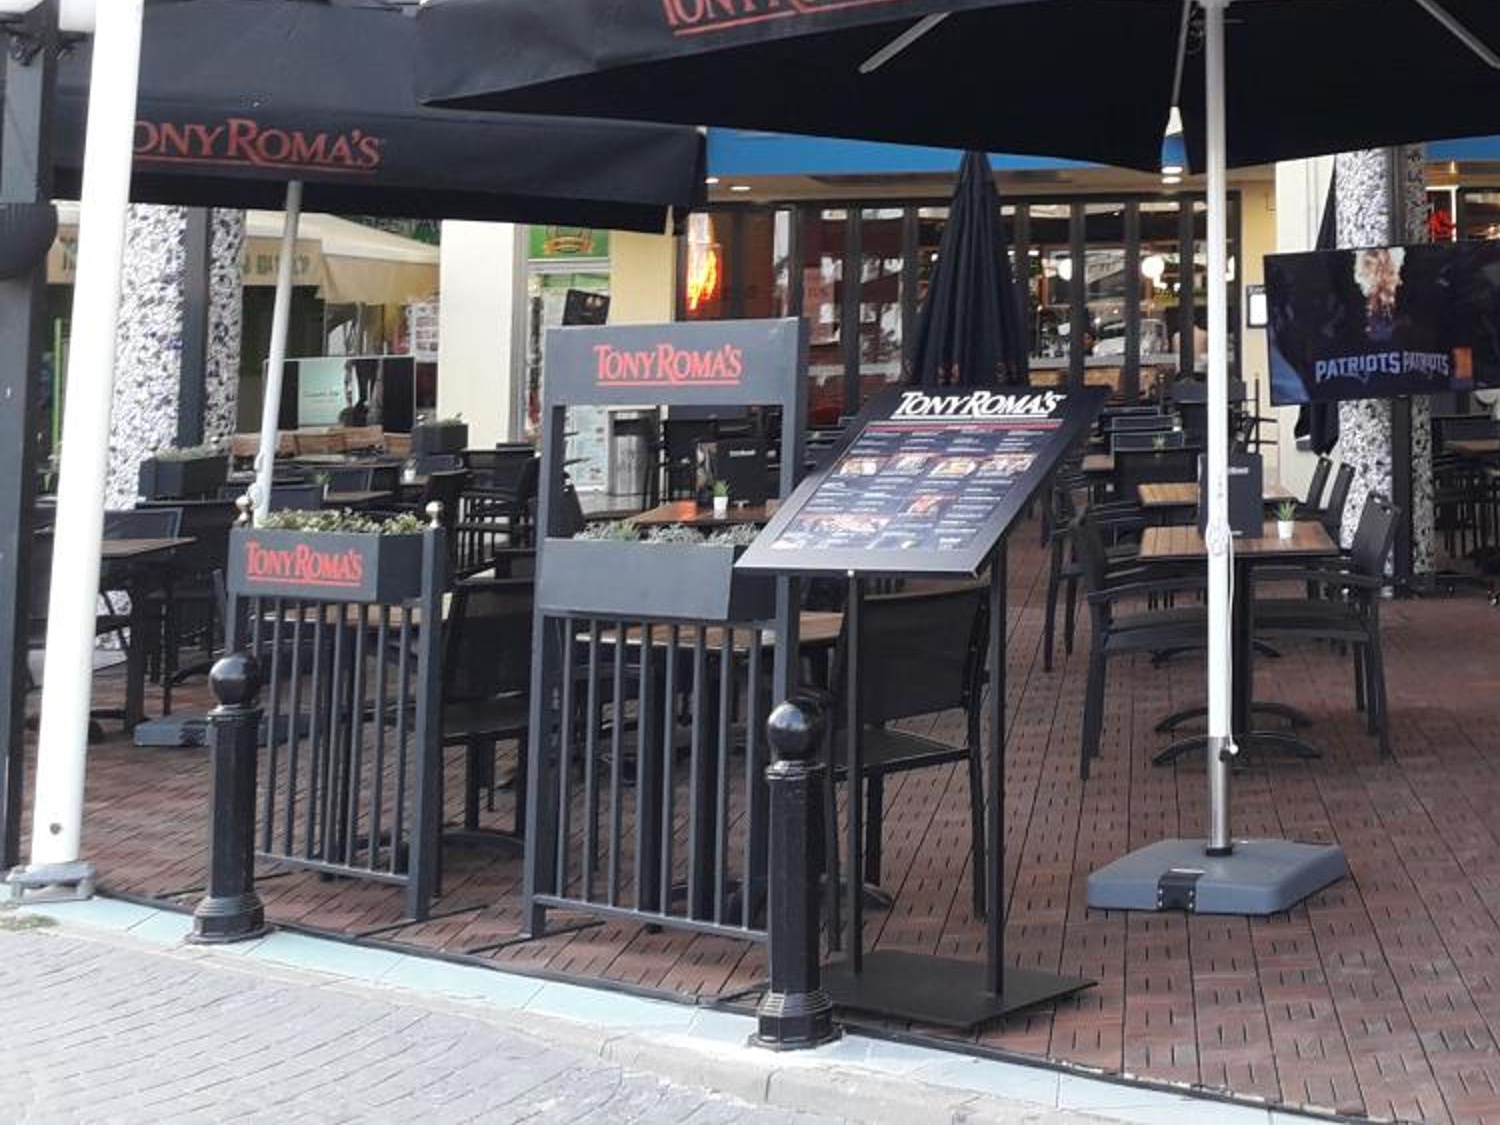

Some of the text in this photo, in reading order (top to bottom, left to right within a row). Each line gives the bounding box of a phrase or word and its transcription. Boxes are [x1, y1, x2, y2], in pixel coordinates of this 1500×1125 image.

[134, 120, 224, 157] ONY
[1315, 350, 1449, 384] PATRIOTS PATRIOTS
